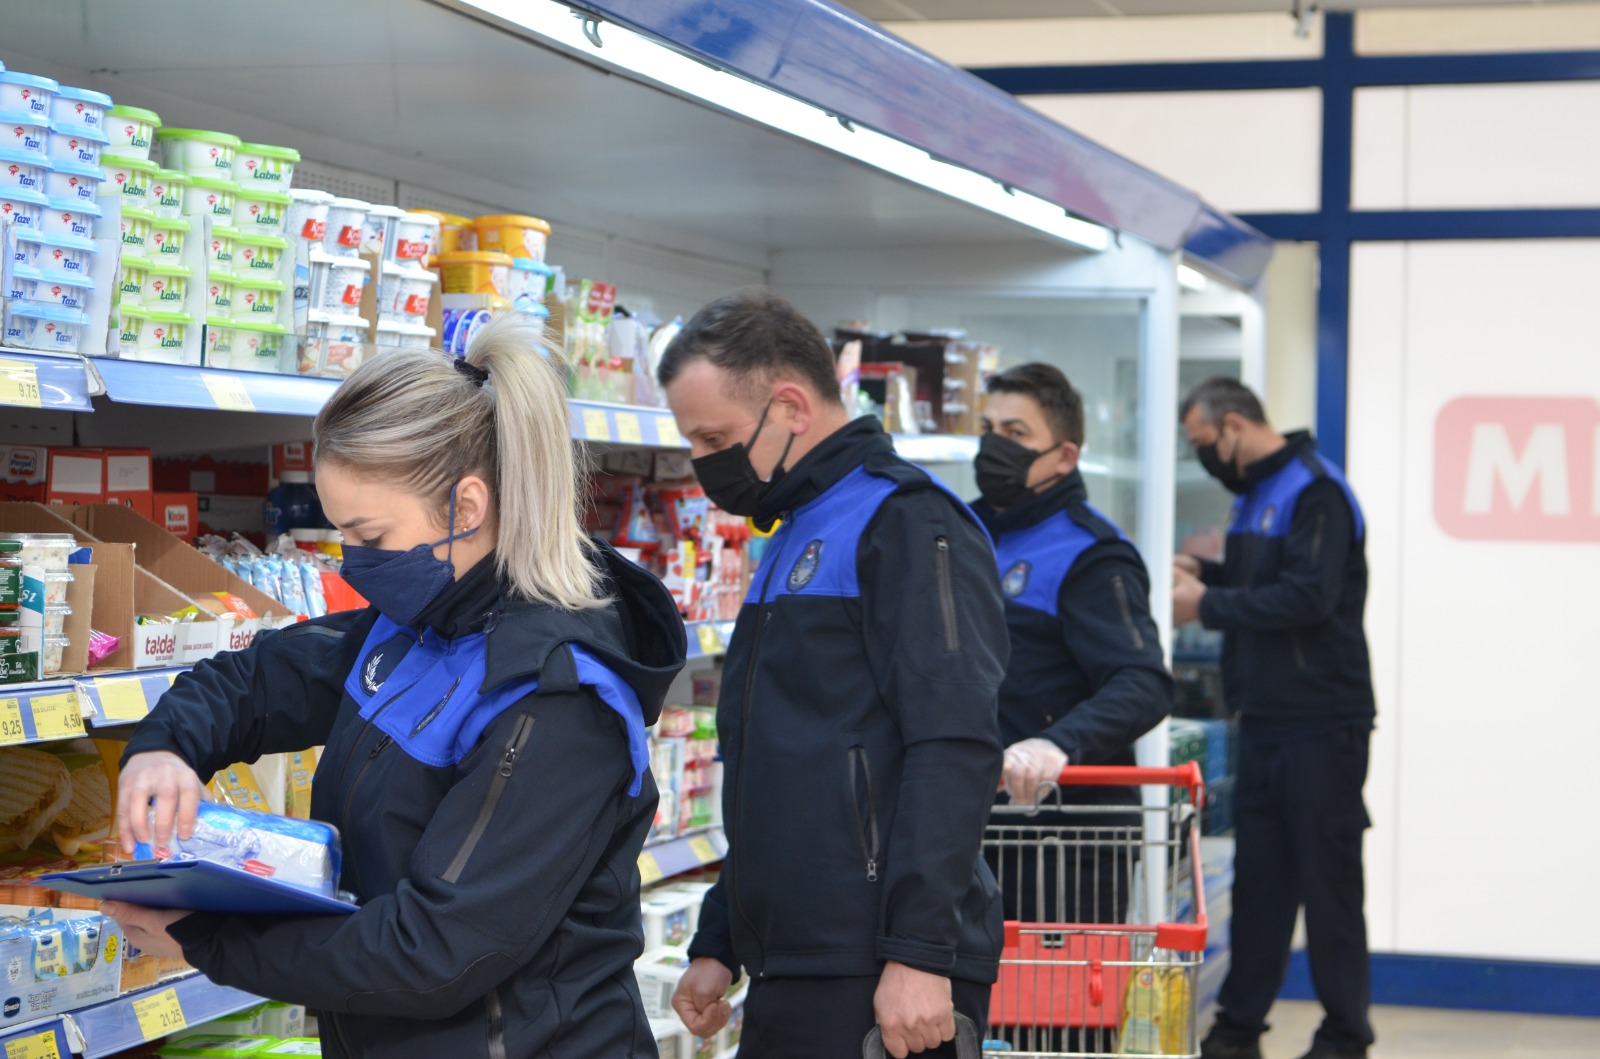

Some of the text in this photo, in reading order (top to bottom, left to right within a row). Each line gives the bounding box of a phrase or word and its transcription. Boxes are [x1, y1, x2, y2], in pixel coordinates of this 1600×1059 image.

[31, 99, 45, 111] Taze
[25, 137, 40, 148] Taze
[79, 149, 93, 160] Taze
[19, 174, 35, 186] Taze
[254, 168, 281, 181] Labne
[78, 186, 91, 198] Taze
[14, 212, 30, 225] Taze
[72, 222, 86, 234] Taze
[63, 258, 80, 270] Taze
[62, 295, 77, 305] Taze
[56, 331, 72, 343] Taze
[1462, 422, 1600, 518] M
[63, 713, 81, 731] 4,50
[2, 720, 22, 738] 9,25
[159, 1009, 183, 1028] 21,25
